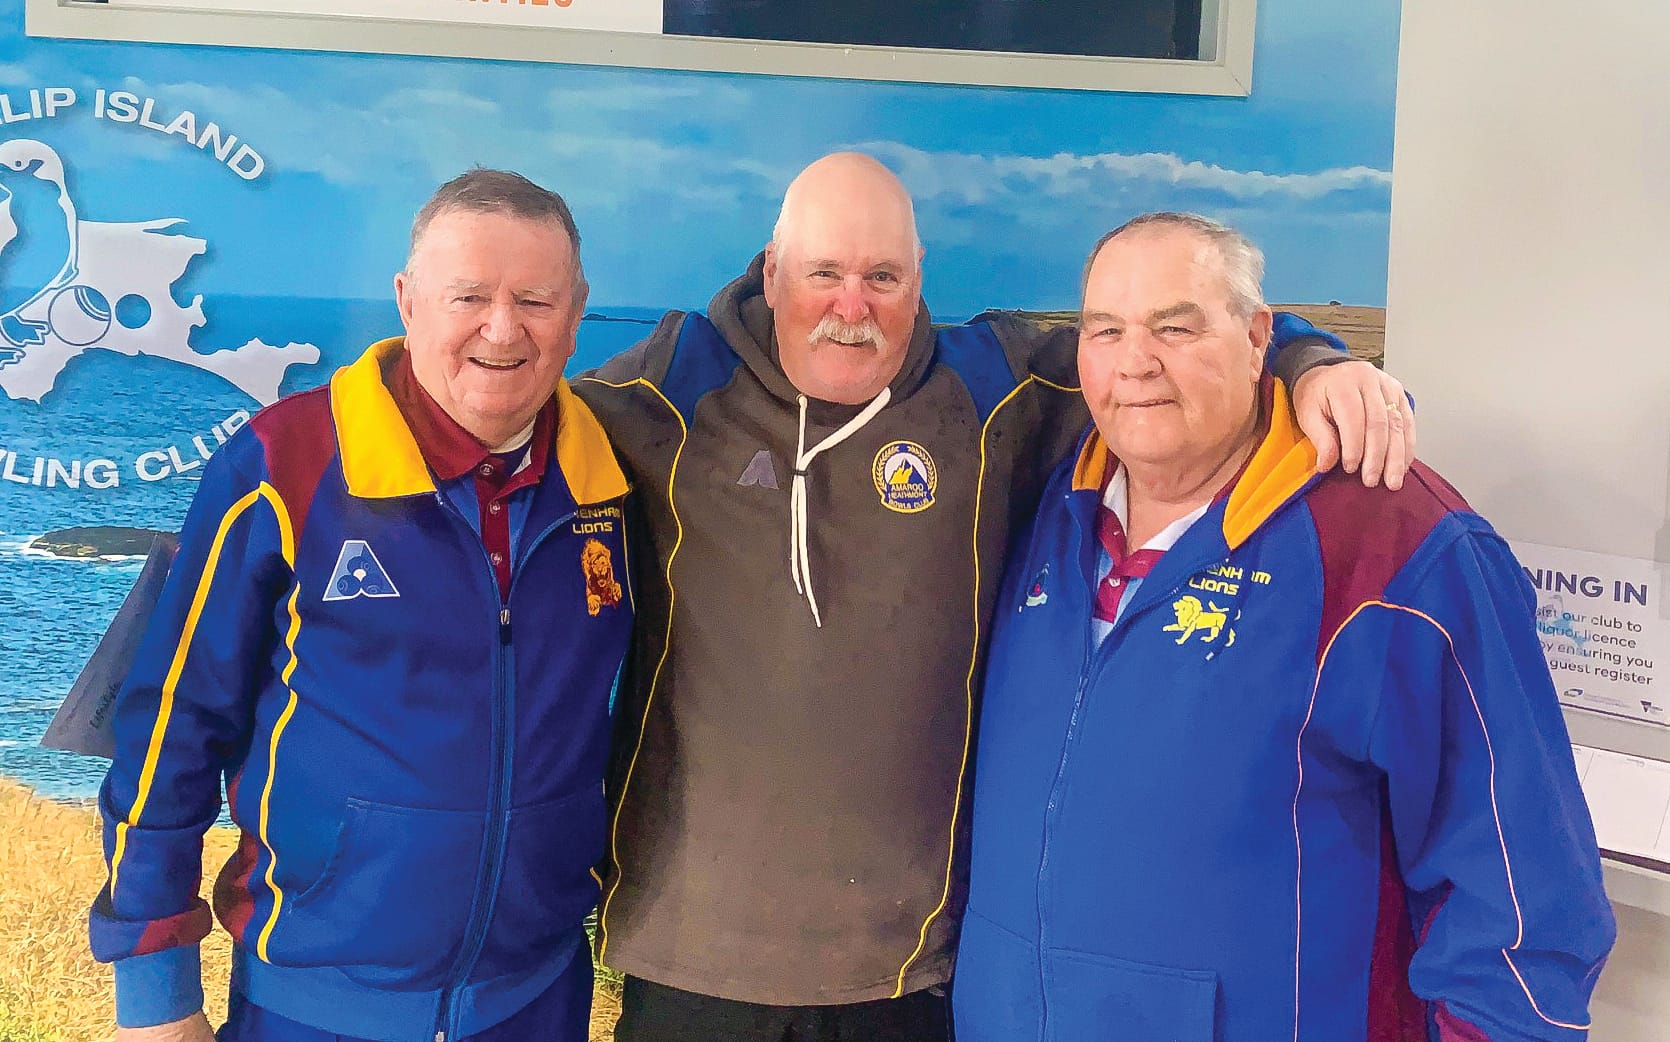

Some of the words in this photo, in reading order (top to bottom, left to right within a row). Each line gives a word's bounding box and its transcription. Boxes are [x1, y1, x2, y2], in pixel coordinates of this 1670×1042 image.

[0, 87, 77, 125] LIP
[94, 89, 265, 180] ISLAND
[0, 449, 120, 489] LING
[572, 521, 613, 534] LIONS
[1188, 577, 1240, 595] LIONS
[1613, 580, 1648, 606] IN
[1538, 620, 1579, 638] liquor
[1584, 629, 1637, 649] licence
[1562, 611, 1588, 623] our
[1591, 614, 1623, 630] club
[1626, 620, 1643, 633] to
[1549, 660, 1591, 674] guest
[1594, 667, 1654, 685] register
[1626, 655, 1654, 669] you
